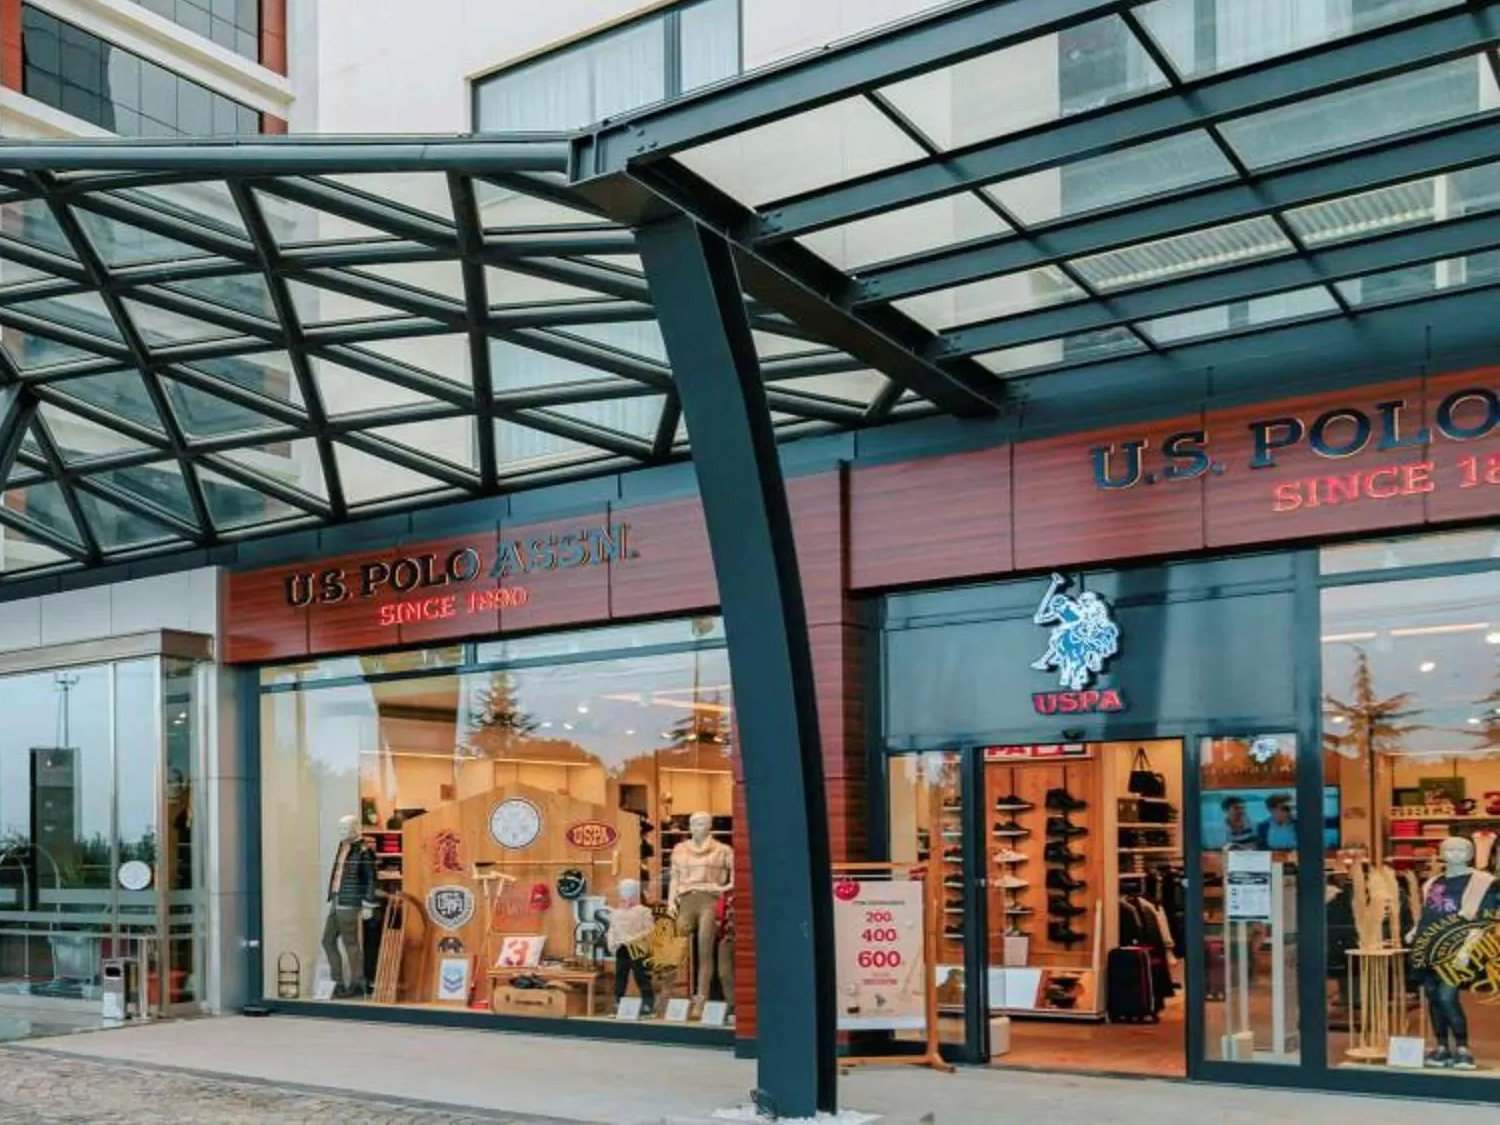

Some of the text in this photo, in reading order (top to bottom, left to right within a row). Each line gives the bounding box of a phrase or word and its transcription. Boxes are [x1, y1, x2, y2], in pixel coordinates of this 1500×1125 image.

[1090, 387, 1500, 491] U.S. POLO
[1273, 461, 1436, 512] SINCE
[360, 547, 481, 598] POLO
[380, 595, 456, 626] SINCE
[1033, 689, 1124, 715] USPA
[861, 928, 897, 943] 400
[858, 950, 902, 968] 600
